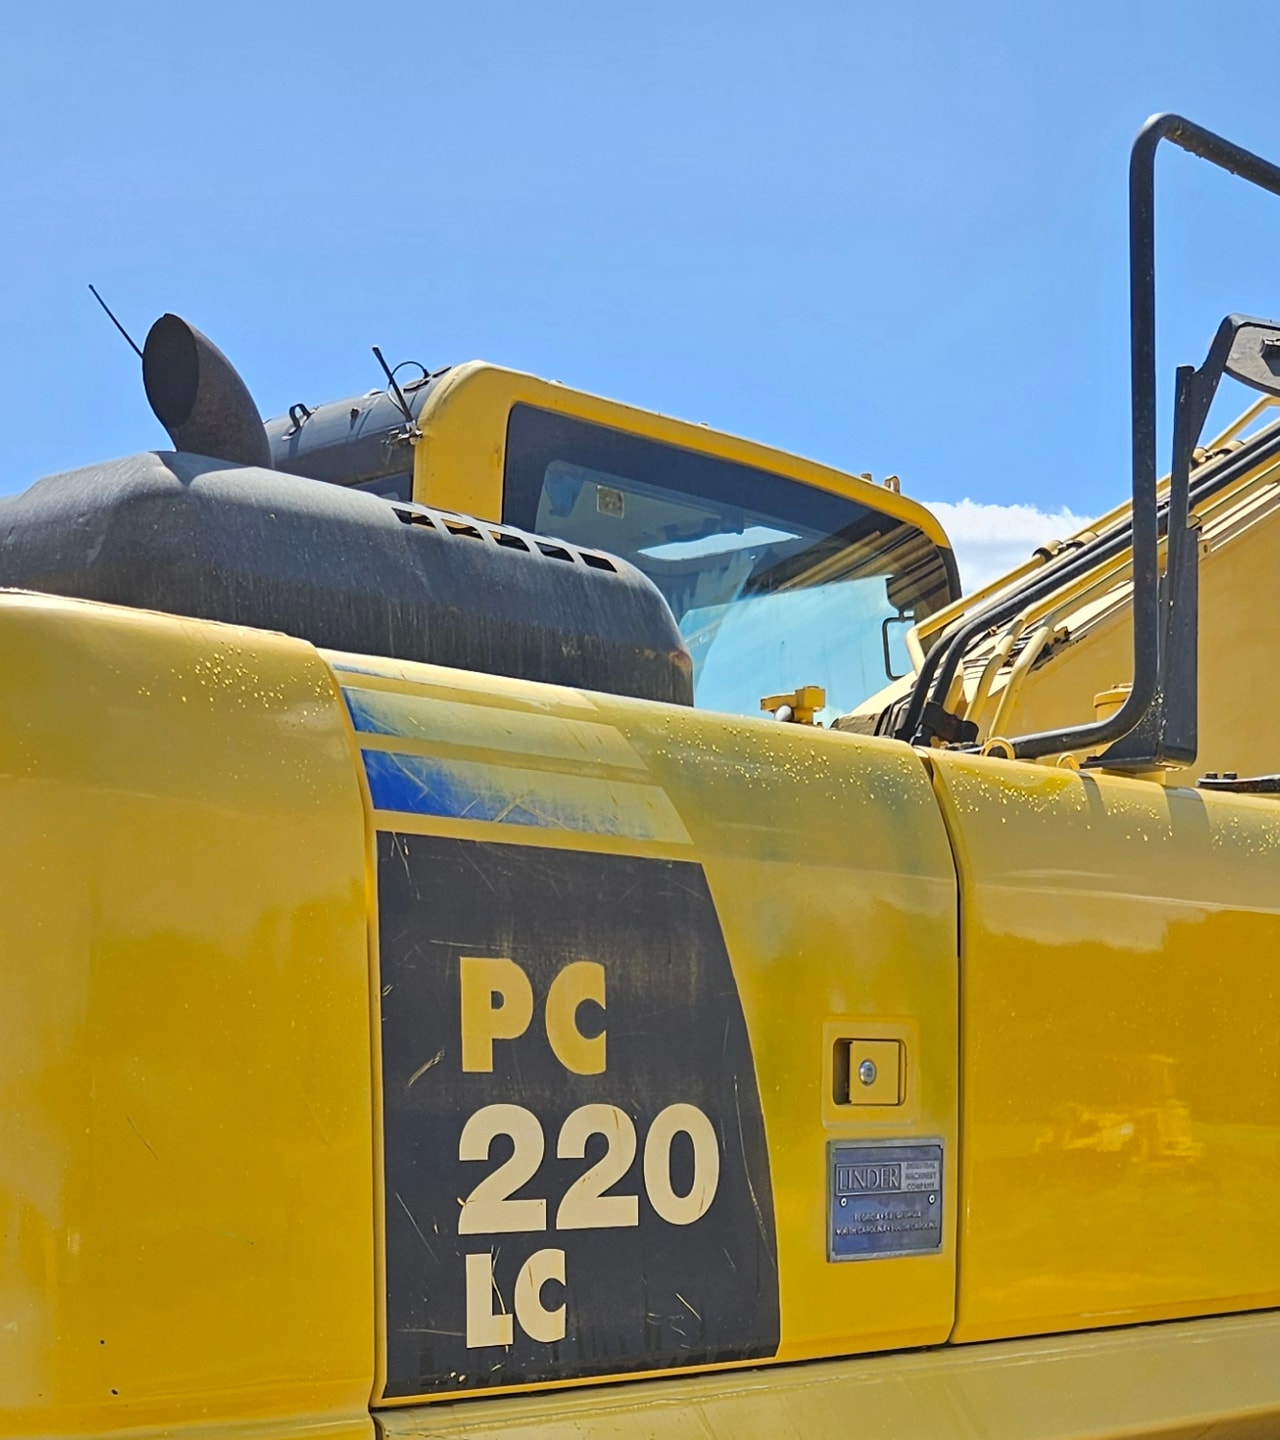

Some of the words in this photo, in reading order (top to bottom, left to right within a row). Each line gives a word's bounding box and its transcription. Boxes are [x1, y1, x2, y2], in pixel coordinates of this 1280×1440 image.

[459, 956, 607, 1076] PC
[458, 1103, 720, 1235] 220
[838, 1167, 899, 1191] LINDER
[466, 1248, 567, 1348] LC
